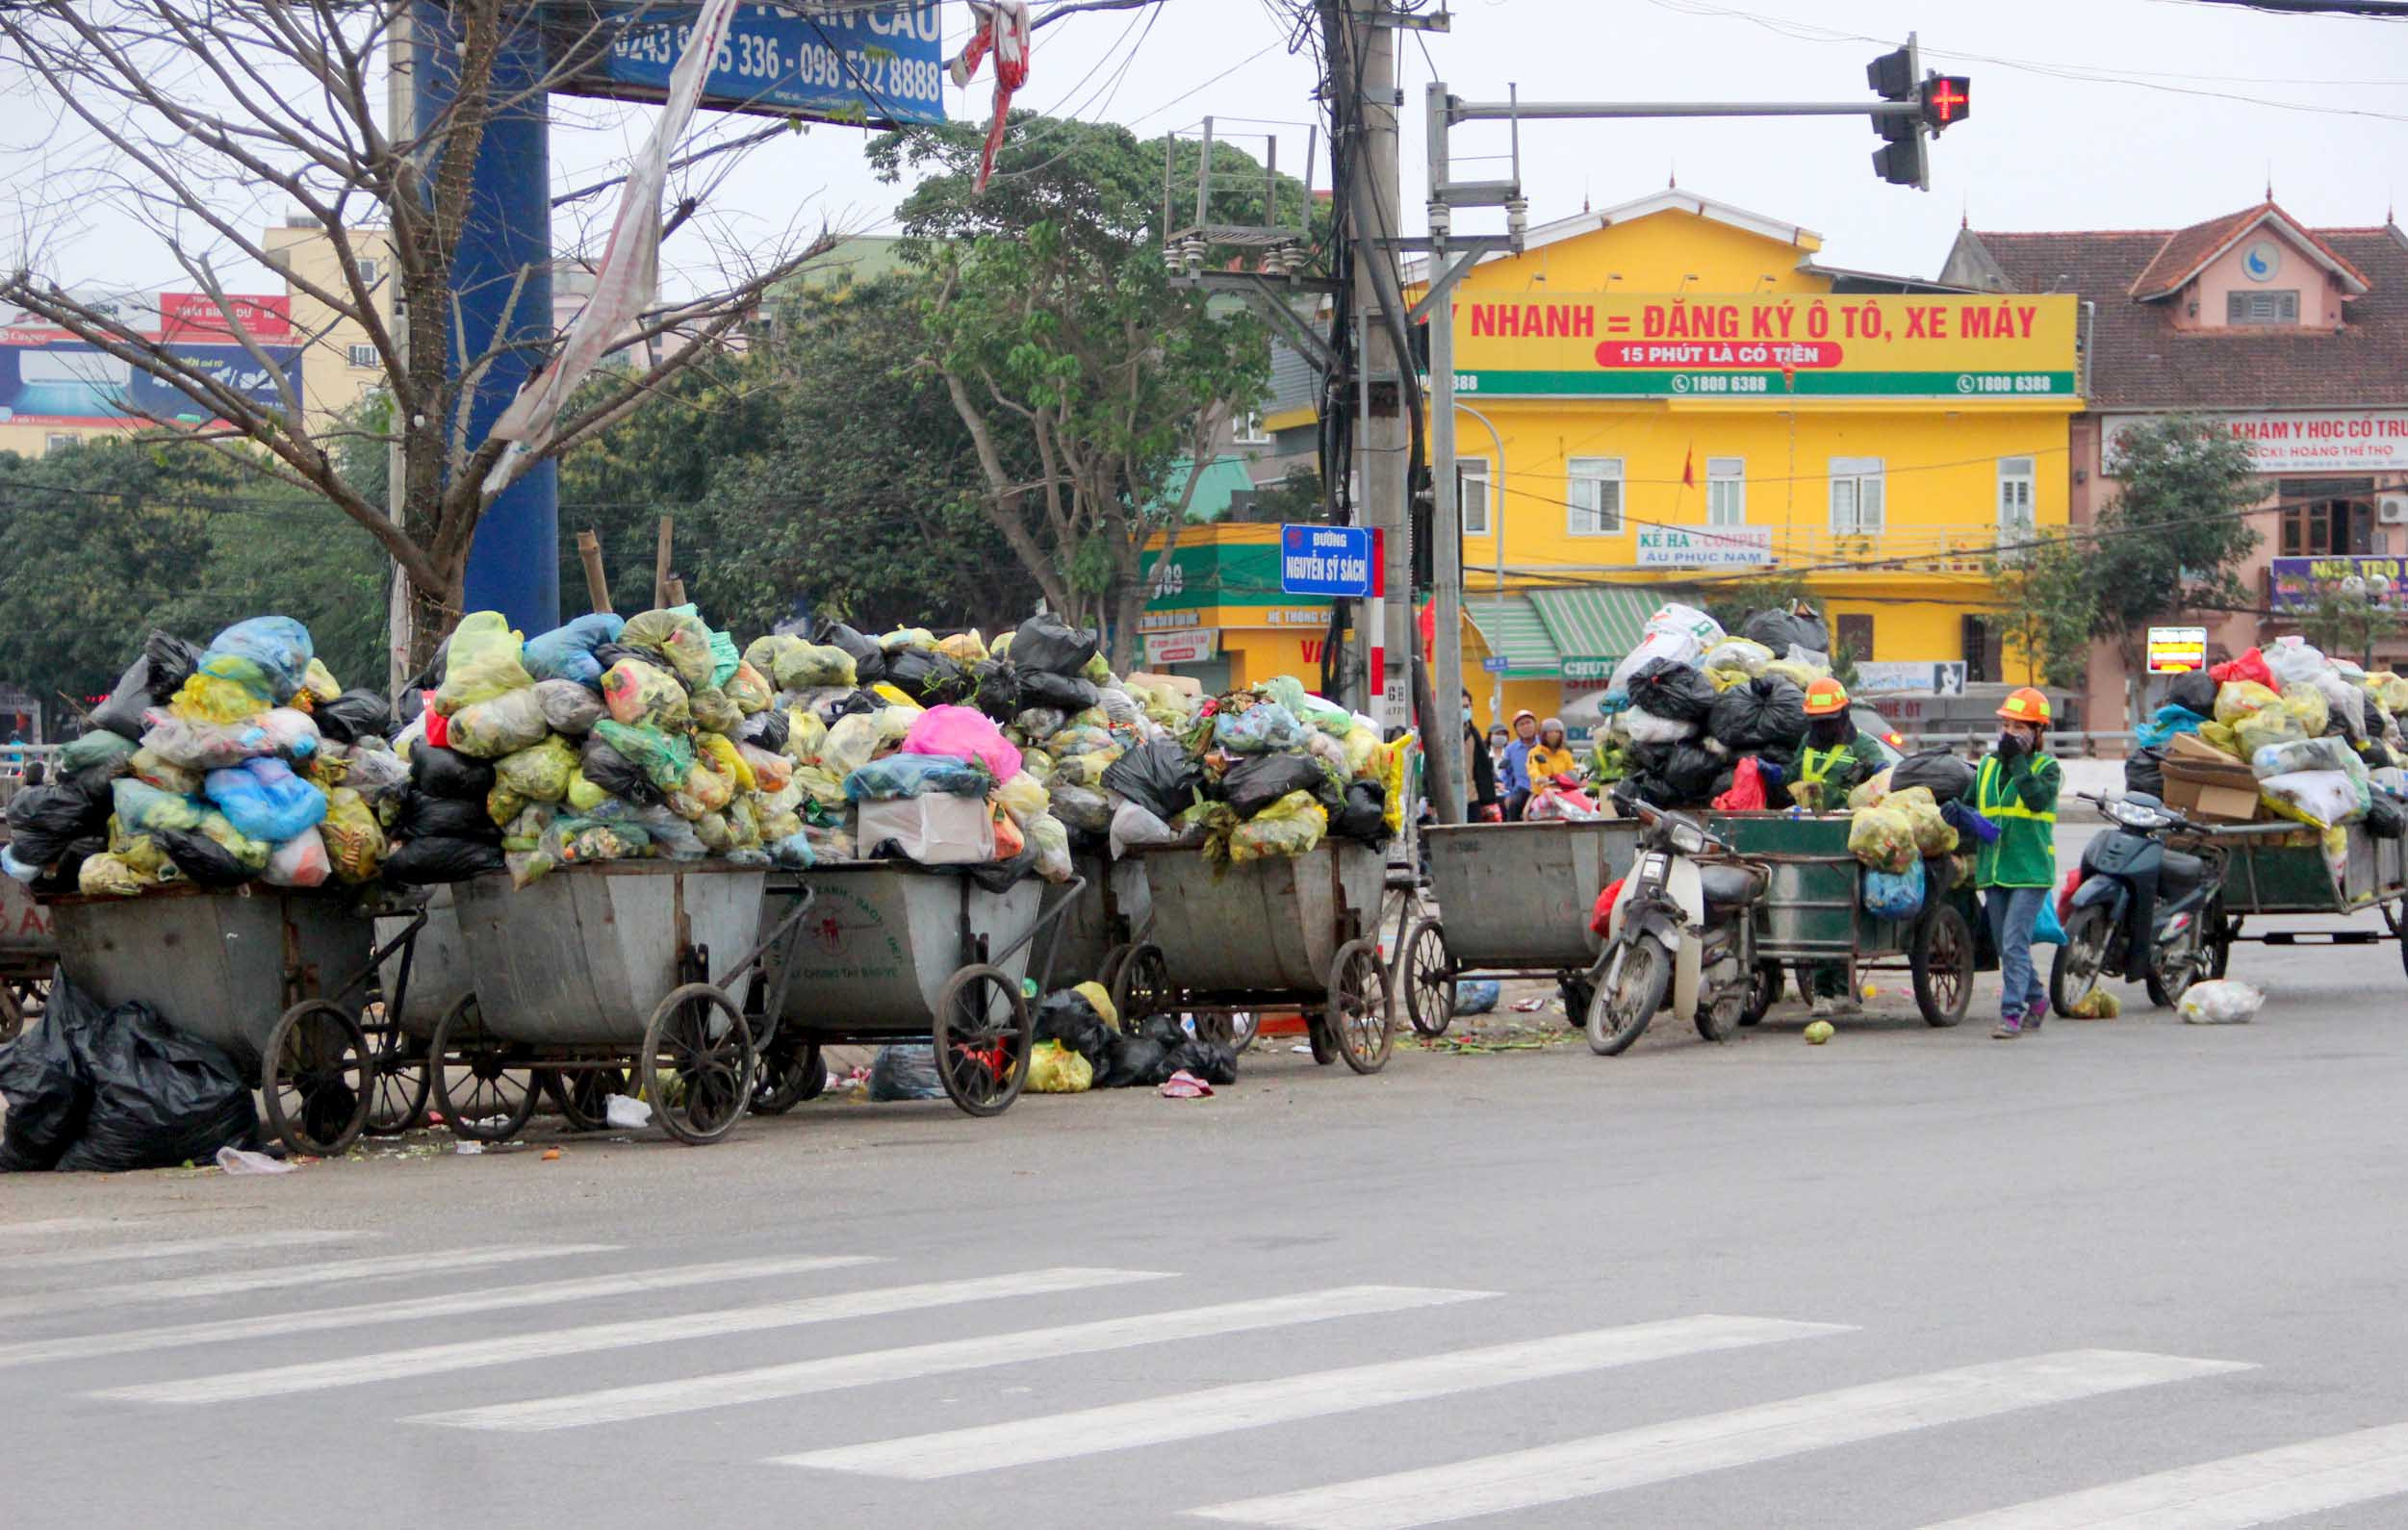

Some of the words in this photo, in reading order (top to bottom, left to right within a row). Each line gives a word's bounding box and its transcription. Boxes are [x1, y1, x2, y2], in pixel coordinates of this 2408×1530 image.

[738, 34, 780, 79] 336
[801, 42, 839, 89] 098
[846, 50, 884, 94] 522
[889, 56, 940, 103] 8888
[1471, 304, 1595, 338] NHANH
[1607, 316, 1631, 333] =
[1643, 298, 1739, 339] ĐĂNG
[1752, 299, 1795, 339] KÝ
[1807, 299, 1829, 339] Ô
[1840, 299, 1893, 344] TÔ,
[1905, 306, 1948, 340] XE
[1960, 299, 2037, 340] MÁY
[1621, 347, 1643, 363] 15
[1649, 343, 1703, 363] PHÚT
[1708, 342, 1733, 363] LÀ
[1739, 343, 1767, 363] CÓ
[1773, 341, 1818, 363] TIỀN
[1691, 375, 1727, 392] 1800
[1731, 375, 1767, 392] 6388
[1976, 375, 2011, 392] 1800
[2015, 375, 2051, 392] 6388
[2232, 418, 2288, 440] KHÁM
[2292, 421, 2304, 440] Y
[2308, 420, 2344, 443] HỌC
[2348, 412, 2373, 439] CỔ
[2290, 444, 2340, 458] HOÀNG
[1312, 530, 1347, 548] ĐƯỜNG
[1286, 549, 1326, 581] NGUYỄN
[1326, 554, 1339, 582] SỸ
[1341, 554, 1367, 583] SÁCH
